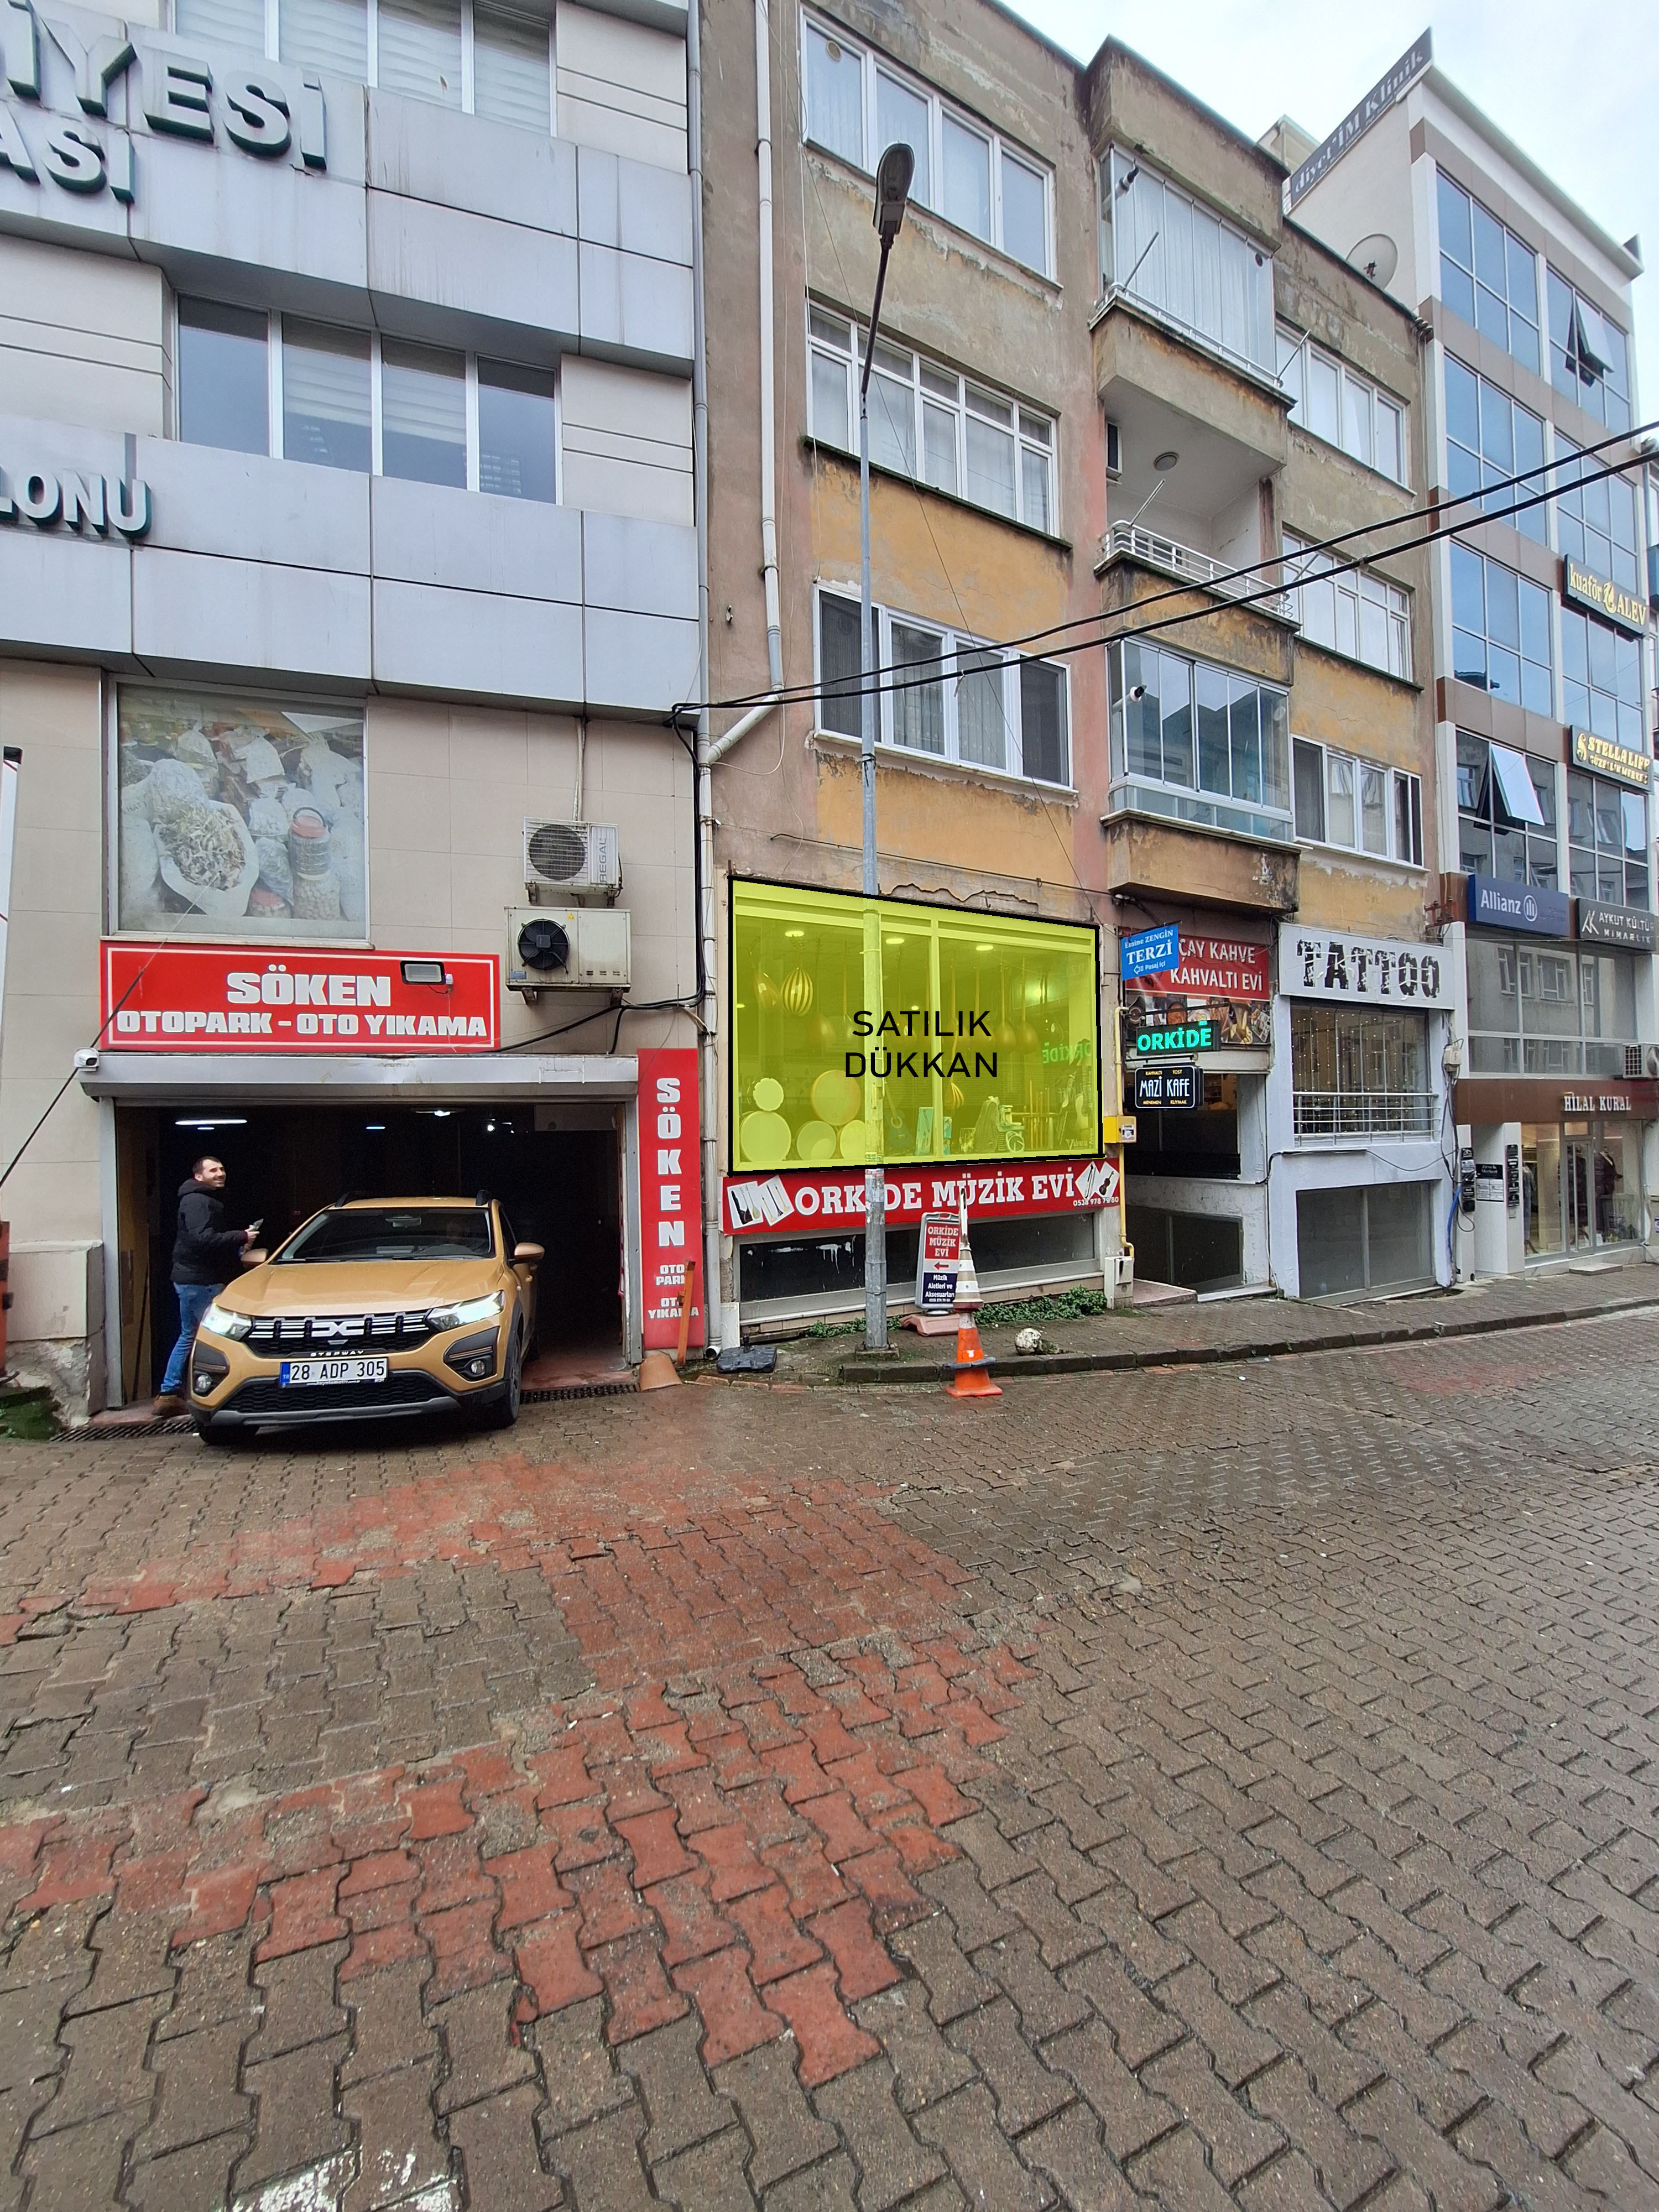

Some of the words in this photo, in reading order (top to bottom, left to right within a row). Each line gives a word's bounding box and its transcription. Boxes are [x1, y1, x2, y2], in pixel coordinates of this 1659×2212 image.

[1365, 50, 1423, 119] Klinik
[0, 466, 151, 537] ONU
[1569, 563, 1603, 603] kuaför
[1617, 593, 1647, 626] ALEV
[1480, 889, 1521, 914] Allianz
[1598, 912, 1625, 926] AYKUT
[1125, 939, 1144, 949] Emine
[1145, 929, 1173, 943] ZENGİN
[1126, 938, 1173, 965] TERZİ
[1178, 938, 1205, 962] ÇAY
[1209, 942, 1256, 964] KAHVE
[1170, 967, 1238, 989] KAHVALTI
[1242, 971, 1262, 992] EVİ
[1297, 940, 1440, 999] TATTOO
[227, 964, 391, 1006] SÖKEN
[116, 1010, 273, 1034] OTOPARK
[296, 1013, 359, 1035] OTO
[364, 1015, 487, 1037] YIKAMA
[1139, 1076, 1162, 1097] MAZİ
[1167, 1078, 1190, 1097] KAFE
[1599, 1096, 1631, 1111] KURAL
[656, 1077, 685, 1247] SÖKEN
[795, 1182, 922, 1215] ORKDE
[932, 1172, 1025, 1208] MÜZİK
[1031, 1166, 1074, 1199] EVİ
[928, 1225, 959, 1236] ORKİDE
[929, 1236, 956, 1247] MÜZİK
[935, 1246, 949, 1257] EVİ
[660, 1264, 685, 1274] OTO
[661, 1297, 679, 1307] OT
[291, 1364, 310, 1381] 28
[320, 1363, 349, 1379] ADP
[357, 1360, 385, 1377] 305
